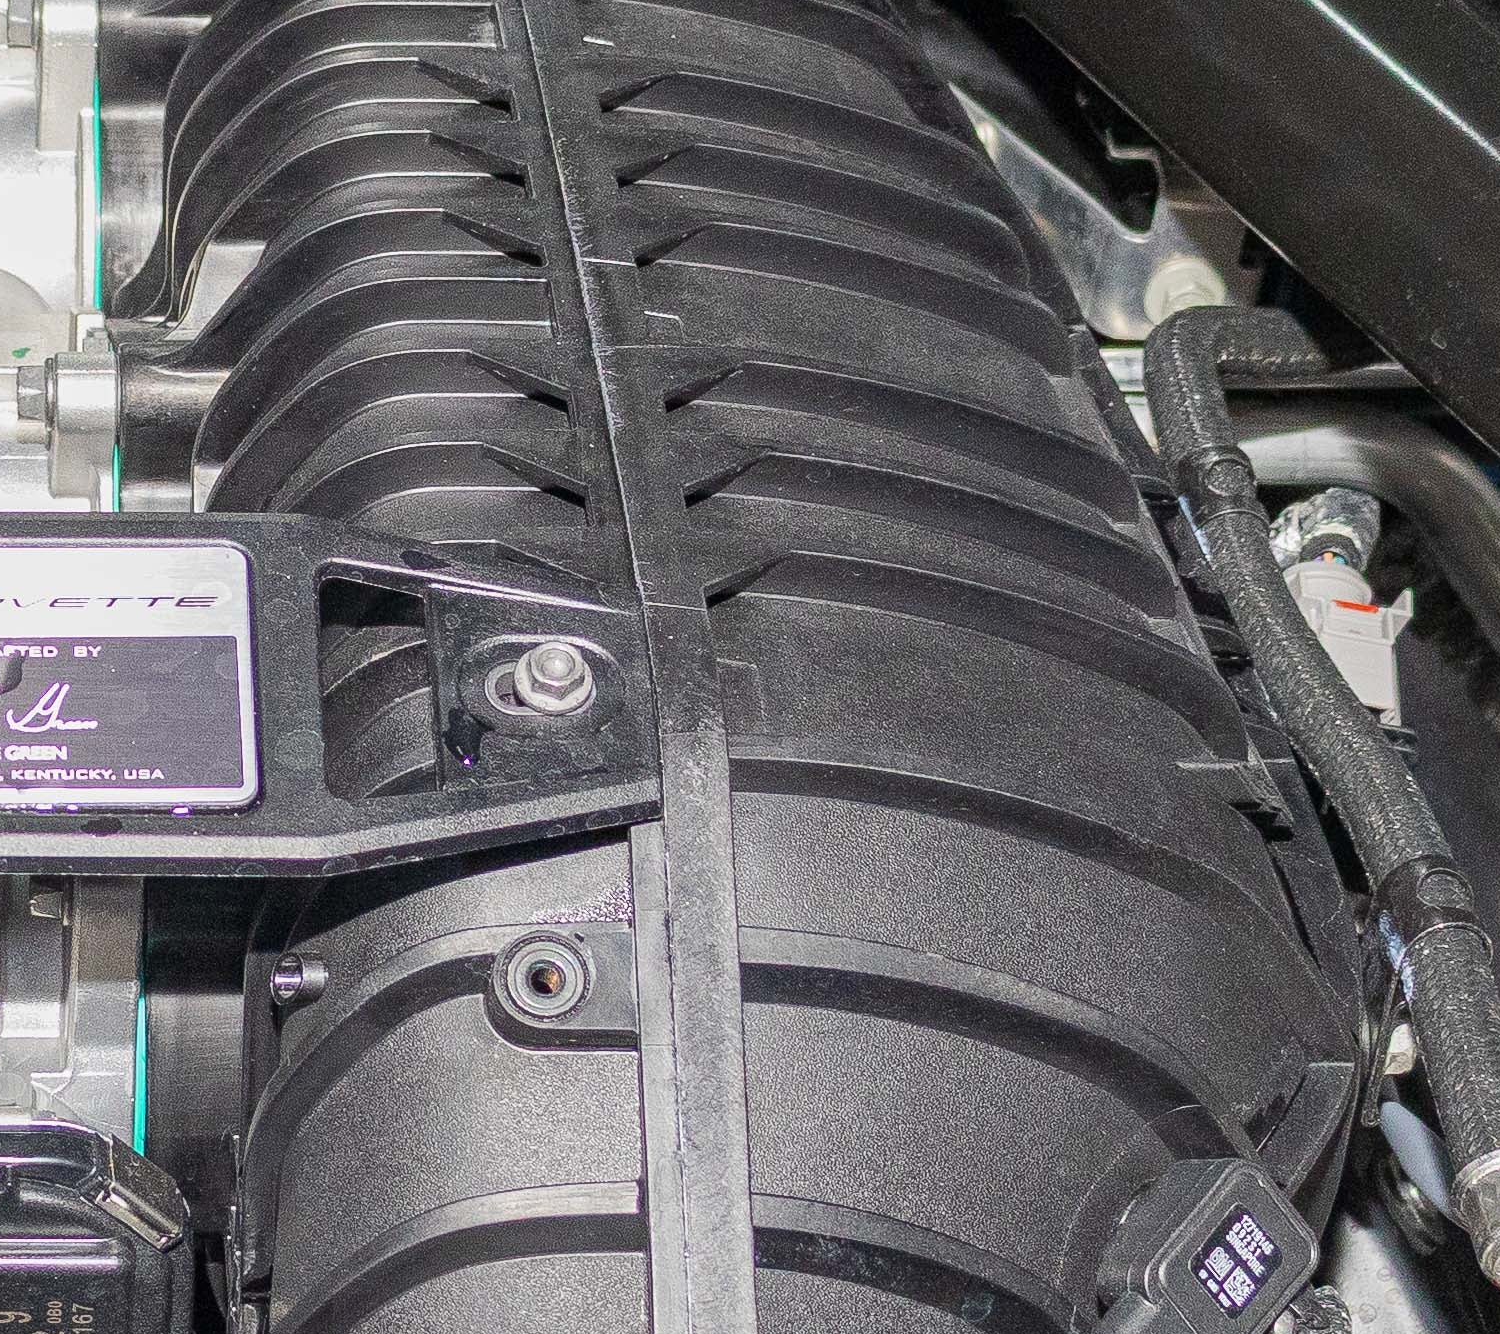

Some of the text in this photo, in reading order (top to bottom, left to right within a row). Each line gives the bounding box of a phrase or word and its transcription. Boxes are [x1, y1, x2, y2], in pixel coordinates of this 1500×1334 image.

[73, 645, 102, 658] BY
[4, 744, 68, 761] GREEN
[10, 768, 117, 781] KENTUCKY,
[123, 768, 165, 781] USA
[1225, 1230, 1266, 1278] SINGAPORE
